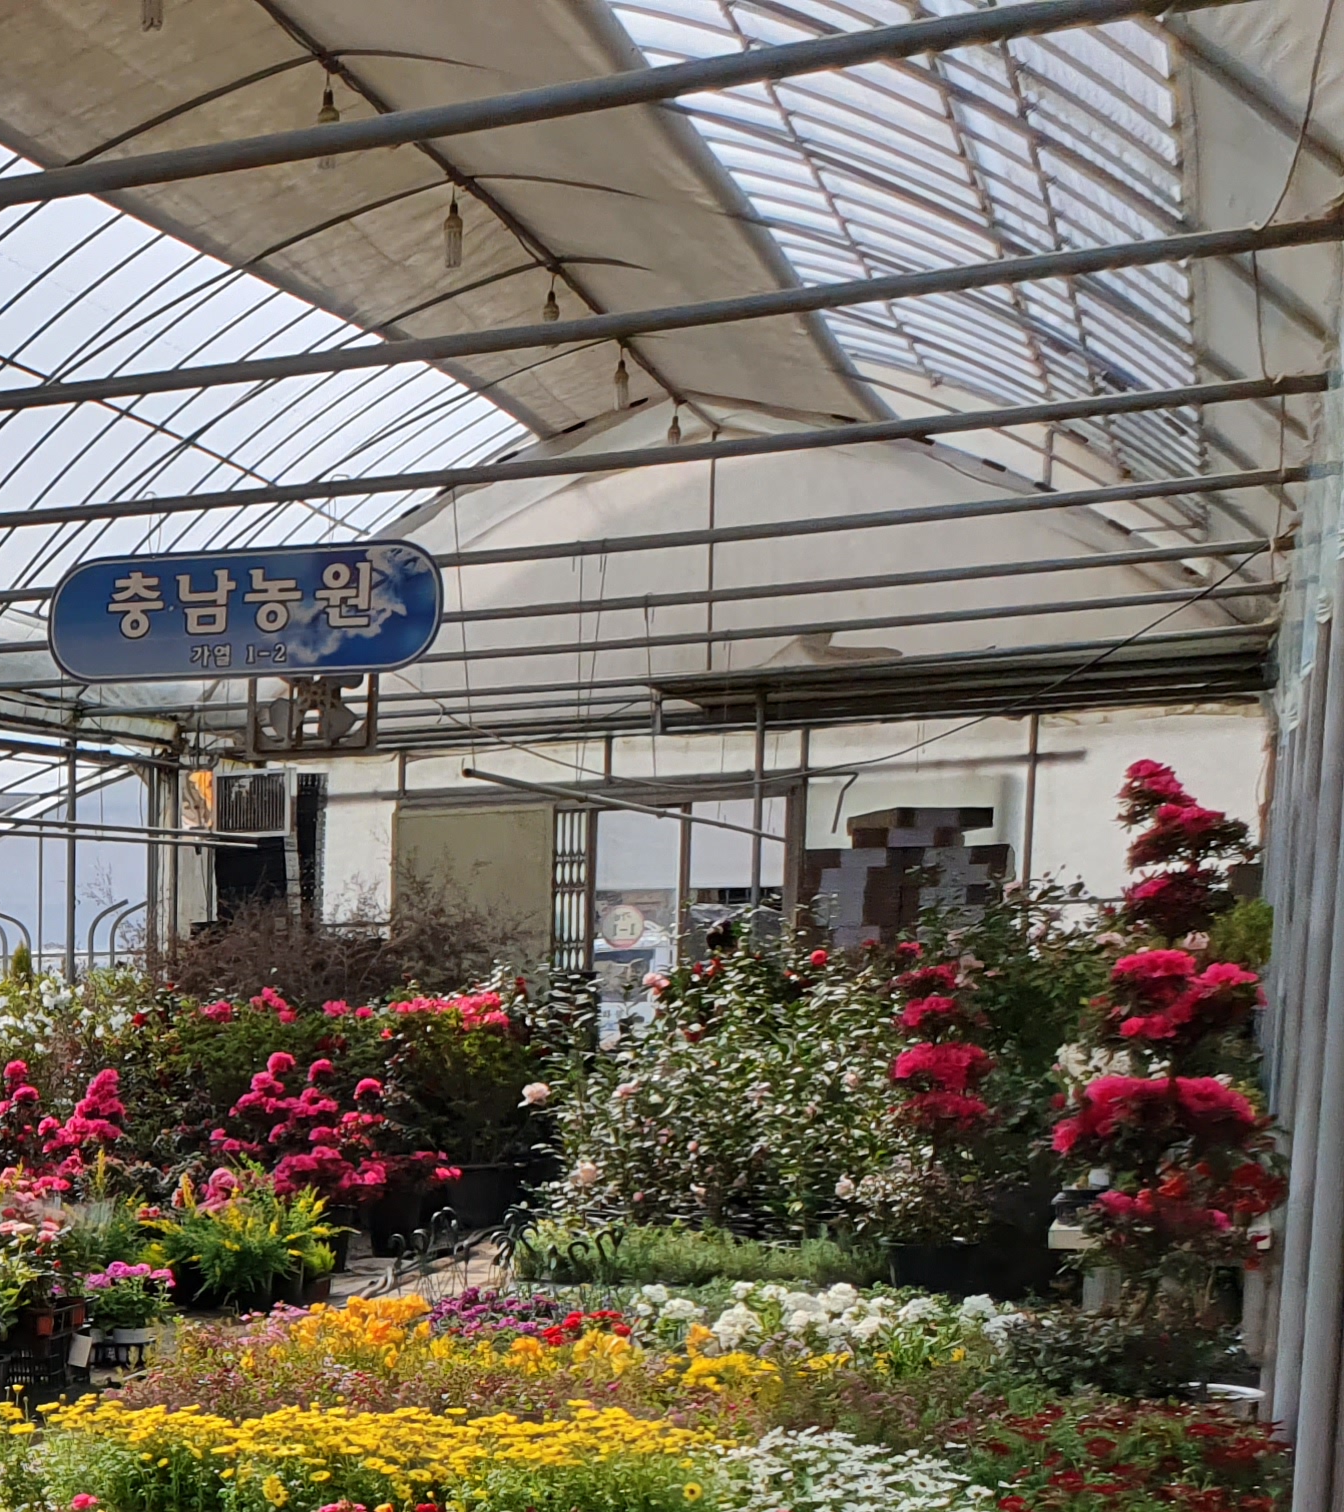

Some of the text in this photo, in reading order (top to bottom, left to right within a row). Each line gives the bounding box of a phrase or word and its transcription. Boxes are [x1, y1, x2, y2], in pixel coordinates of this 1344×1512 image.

[108, 561, 374, 640] 충남농원
[190, 641, 287, 668] 가열 1-2
